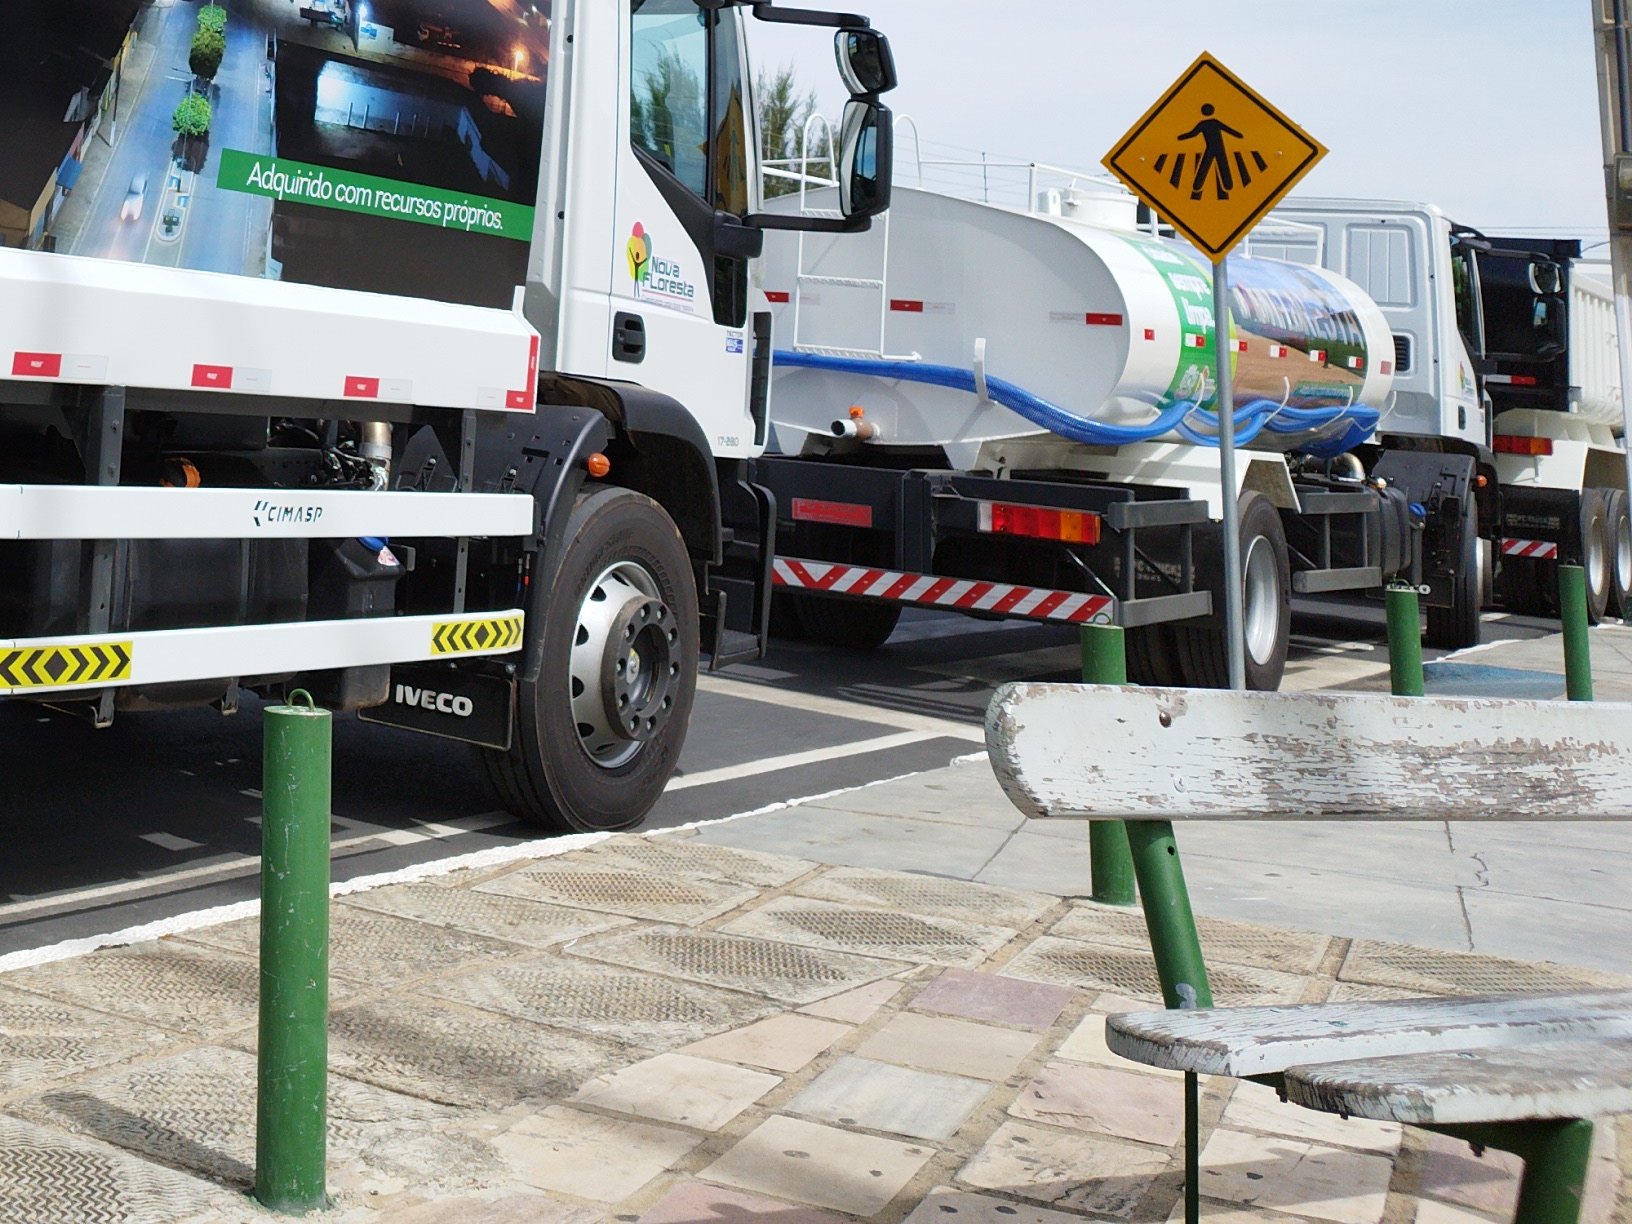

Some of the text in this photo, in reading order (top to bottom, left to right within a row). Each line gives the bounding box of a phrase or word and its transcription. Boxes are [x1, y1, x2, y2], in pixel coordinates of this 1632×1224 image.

[246, 161, 504, 232] Adquirido com recursos próprios.
[652, 256, 680, 278] Nova
[268, 506, 323, 522] CIMASP
[395, 684, 473, 716] IVECO
